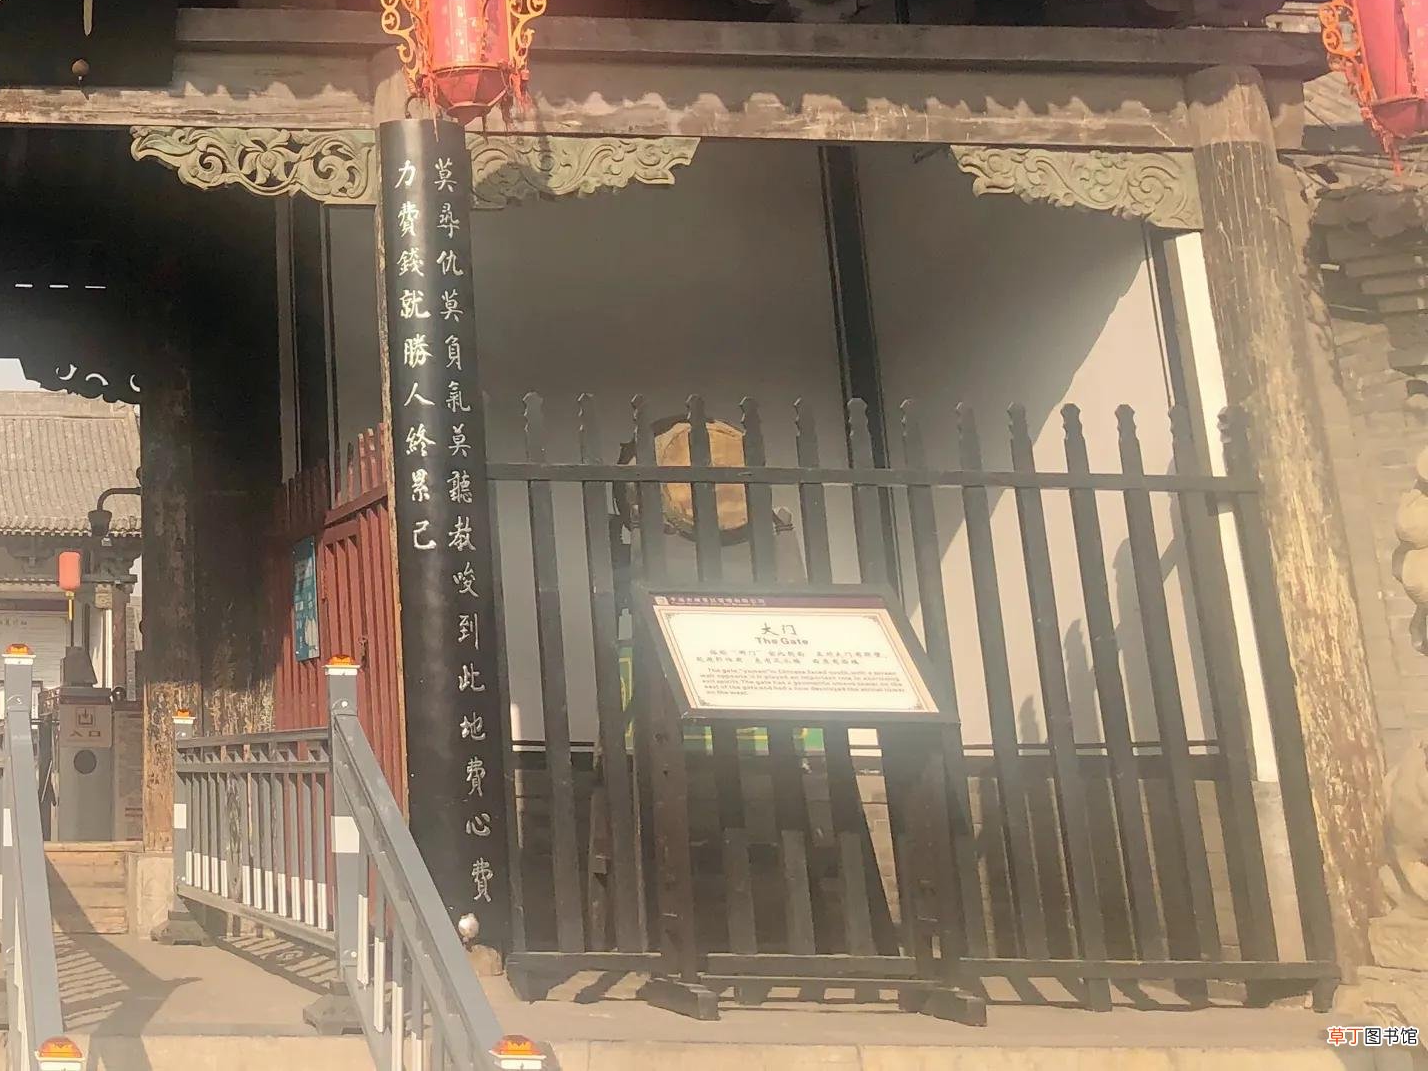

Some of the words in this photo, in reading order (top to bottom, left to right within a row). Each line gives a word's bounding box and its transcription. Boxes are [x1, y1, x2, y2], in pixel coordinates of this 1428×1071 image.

[760, 621, 797, 636] 大门
[755, 637, 778, 645] The
[780, 637, 809, 646] Gate
